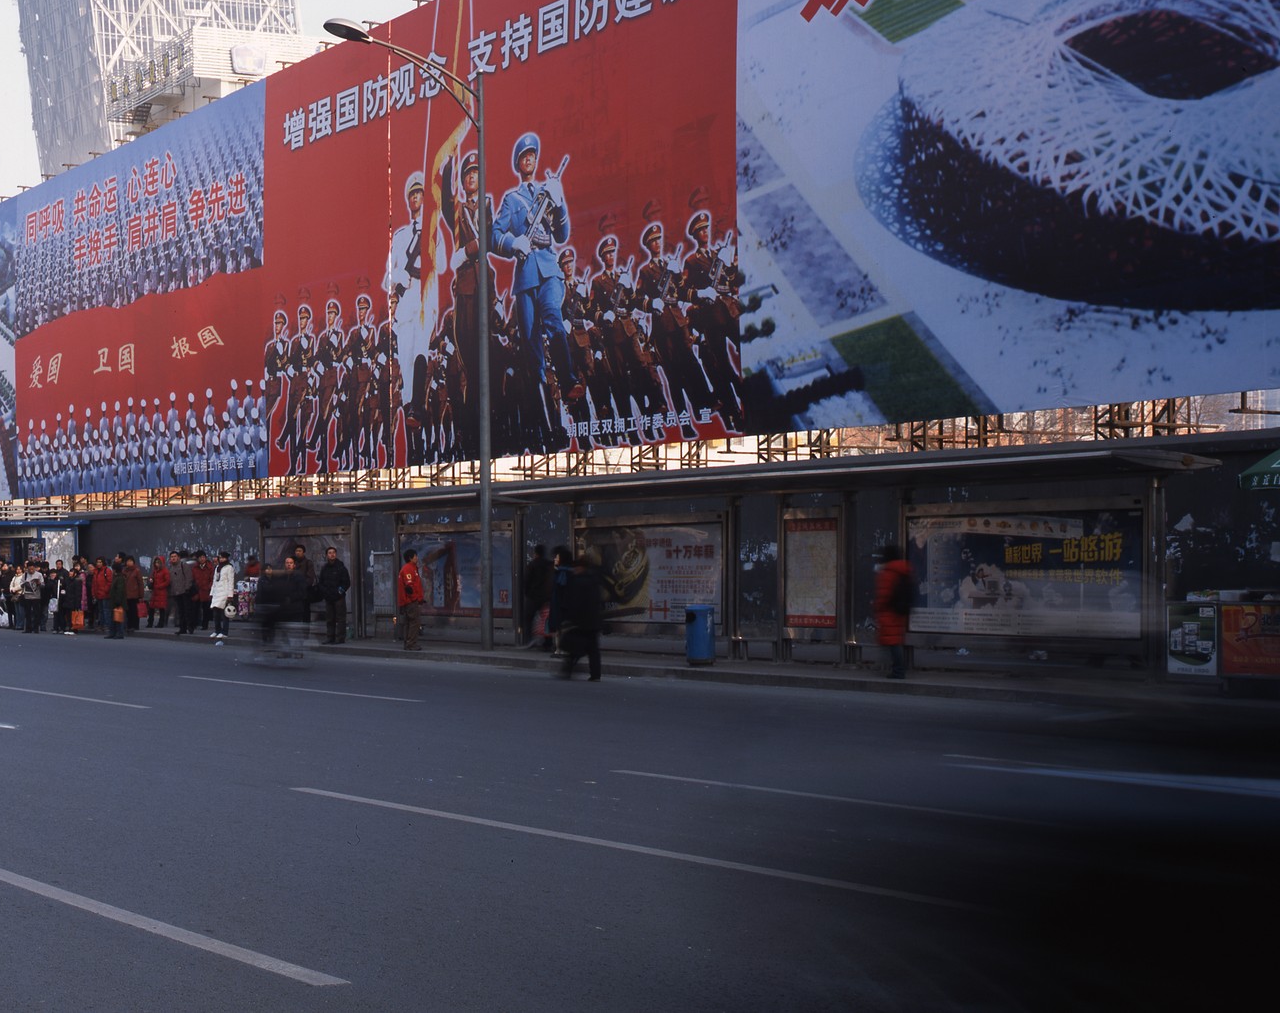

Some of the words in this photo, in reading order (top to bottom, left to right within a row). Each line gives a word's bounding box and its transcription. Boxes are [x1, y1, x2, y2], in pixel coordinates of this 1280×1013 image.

[283, 50, 448, 151] 增强国防观念
[25, 199, 65, 246] 同呼吸
[73, 176, 118, 226] 共命运
[127, 152, 177, 203] 心连心
[73, 223, 118, 271] 手挽手
[127, 201, 178, 253] 肩并肩
[188, 172, 246, 230] 争先进
[29, 352, 62, 388] 爱国
[93, 343, 135, 375] 卫国
[171, 325, 224, 359] 报国
[567, 409, 691, 437] 朝阳区双拥工作委员会
[699, 408, 713, 424] 宣
[248, 453, 256, 468] 宣
[1004, 542, 1042, 564] 精彩世界
